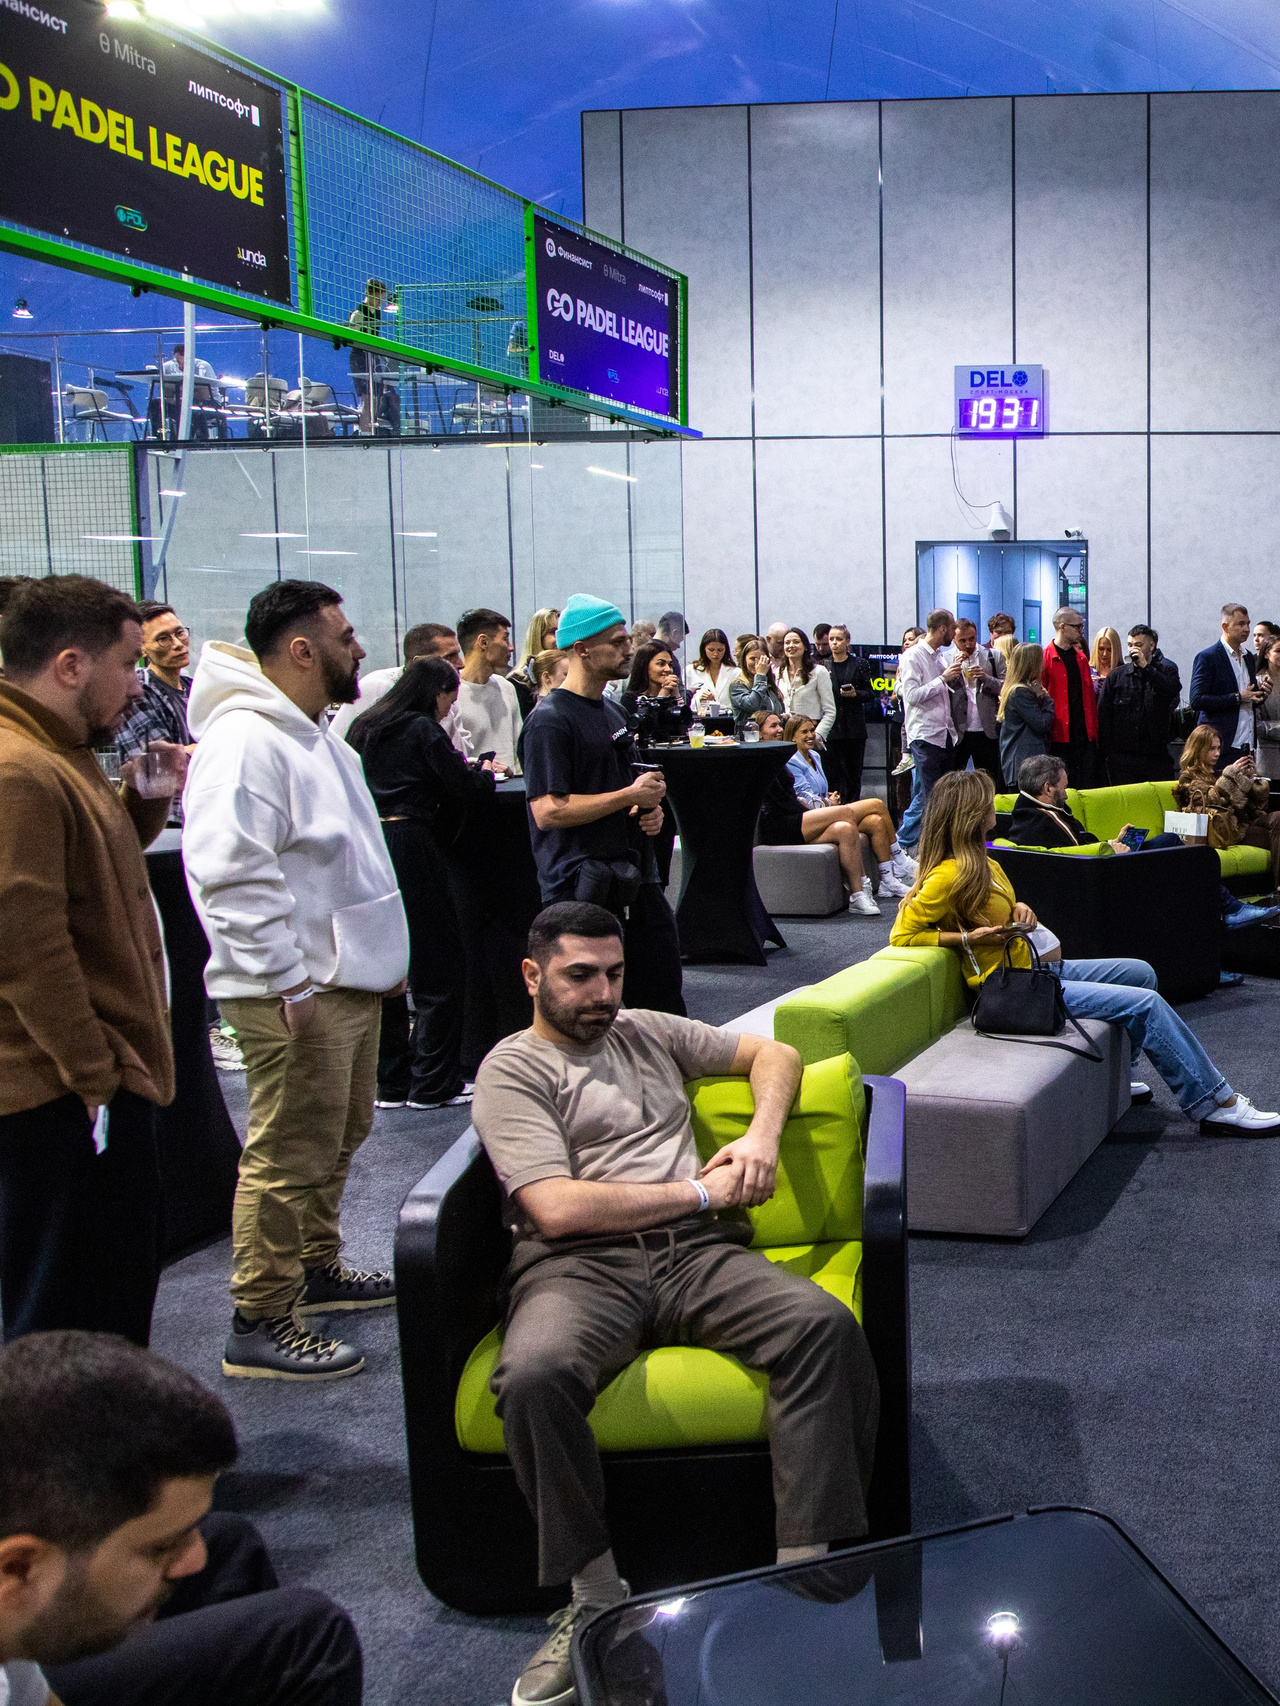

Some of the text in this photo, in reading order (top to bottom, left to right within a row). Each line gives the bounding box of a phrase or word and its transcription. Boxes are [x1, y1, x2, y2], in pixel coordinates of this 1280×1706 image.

[114, 39, 156, 75] Mitra
[189, 80, 250, 118] липтсофт
[29, 76, 143, 161] PADEL
[149, 126, 264, 207] LEAGUE
[558, 246, 592, 270] Финансист
[609, 266, 626, 284] Mitra
[547, 288, 669, 358] GO PADEL LEAGUE
